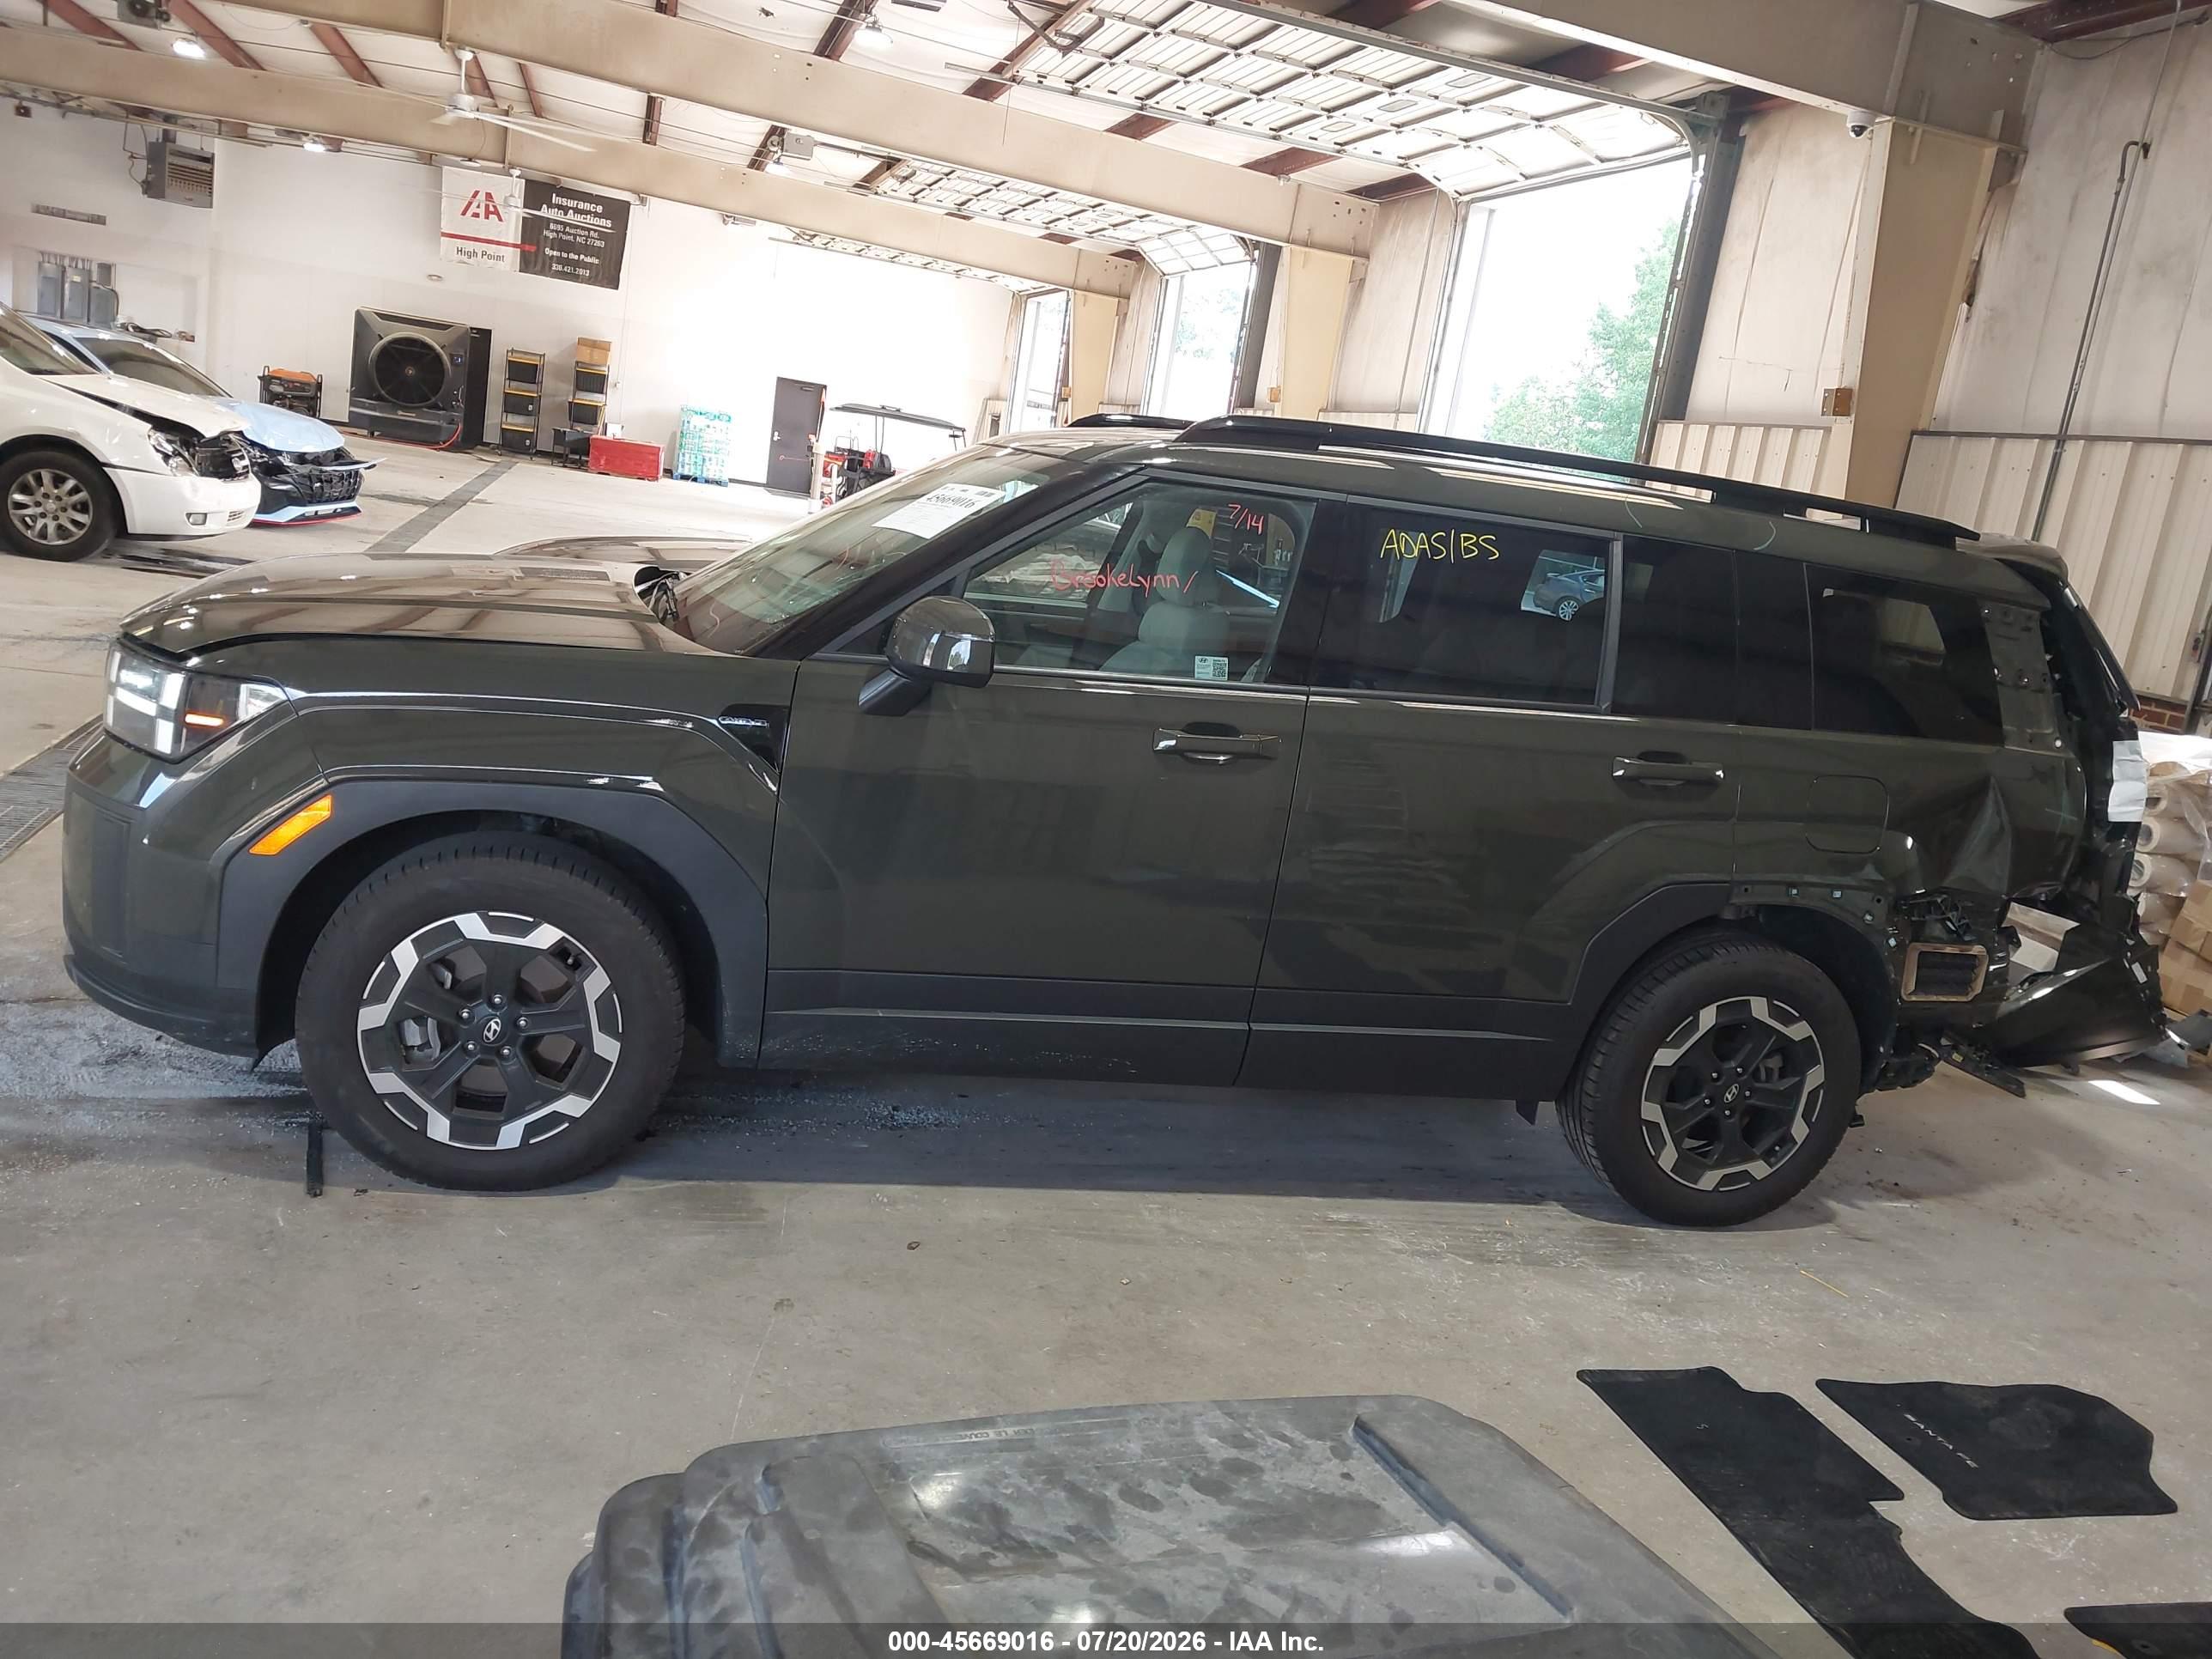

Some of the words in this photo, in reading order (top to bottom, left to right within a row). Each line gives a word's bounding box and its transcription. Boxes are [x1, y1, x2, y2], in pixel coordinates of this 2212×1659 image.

[552, 193, 604, 214] Insurance
[541, 204, 564, 218] Auto
[567, 209, 612, 228] Auctions
[543, 228, 557, 240] High
[576, 235, 586, 244] NC
[565, 226, 588, 236] Auction
[589, 230, 600, 239] Rd.
[456, 246, 478, 259] High
[481, 250, 505, 263] Point
[544, 247, 561, 257] Open
[580, 254, 599, 264] Public
[1228, 503, 1265, 535] 7/14
